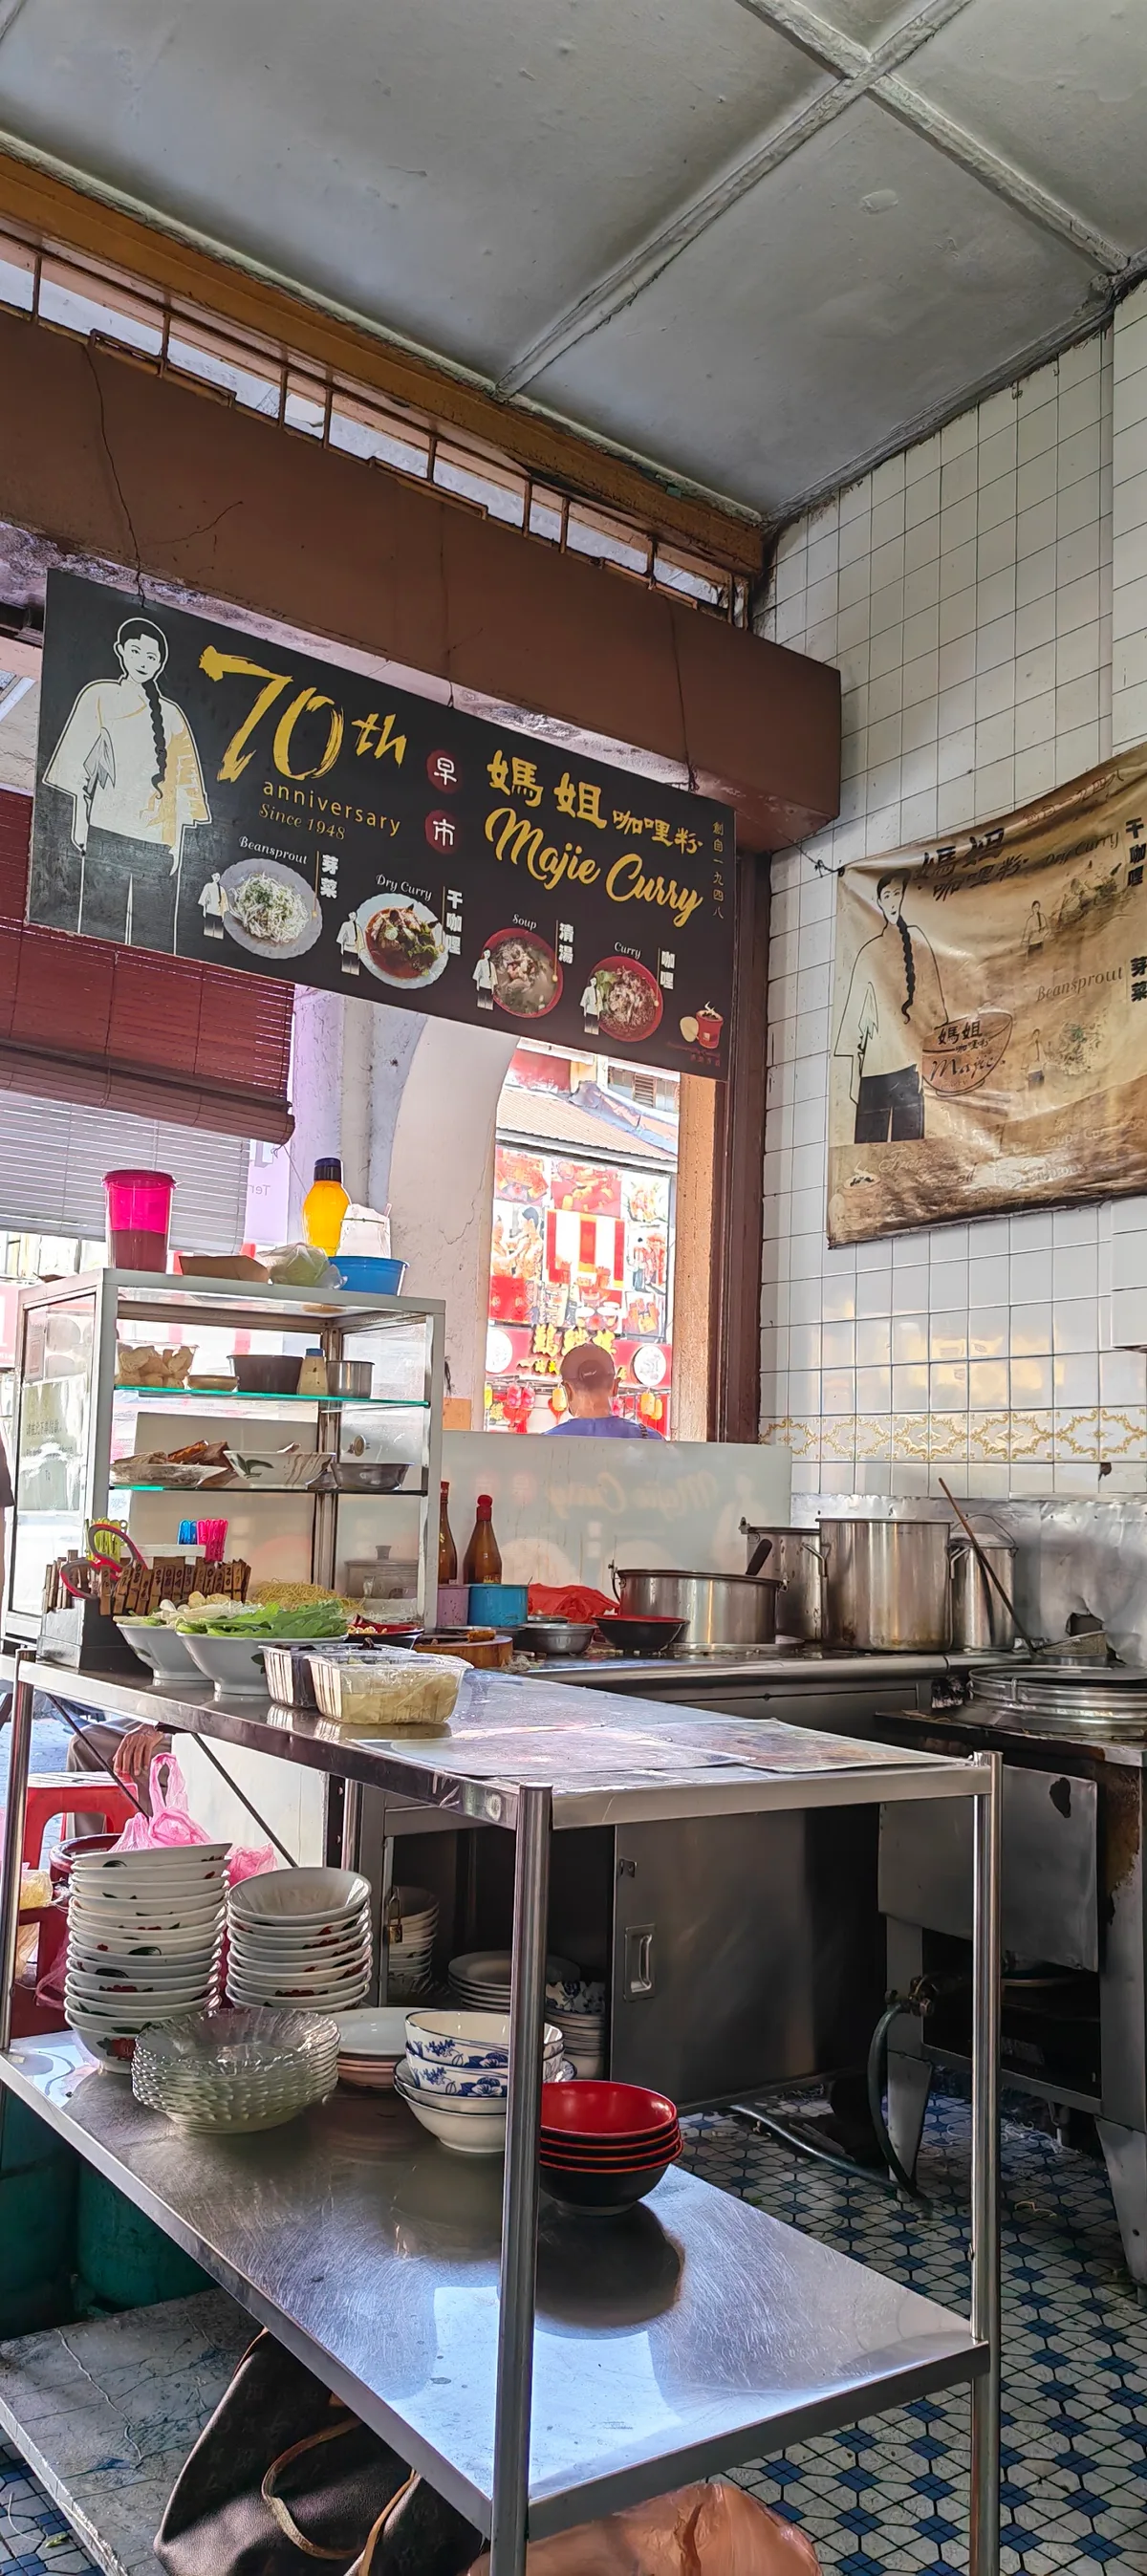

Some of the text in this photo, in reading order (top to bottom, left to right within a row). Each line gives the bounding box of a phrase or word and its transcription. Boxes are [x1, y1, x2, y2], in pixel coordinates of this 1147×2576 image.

[198, 644, 408, 784] 70th
[258, 802, 346, 842] Since 1948
[262, 781, 402, 837] anniversary
[486, 748, 704, 856] 媽姐 咖哩粉
[238, 834, 309, 866] Beansprout
[1074, 830, 1121, 856] Curry
[1125, 816, 1147, 888] 干咖哩
[320, 854, 340, 899] 芽菜
[376, 874, 434, 902] Dry Curry
[484, 806, 704, 928] Majie Curry
[711, 820, 725, 920] 創自一九四八
[446, 889, 465, 956] 干咖哩
[511, 913, 538, 931] Soup
[558, 921, 575, 965] 清湯
[614, 941, 642, 961] Curry
[660, 949, 677, 991] 咖哩
[1036, 965, 1123, 1003] Beansprout
[1130, 955, 1147, 1003] 芽菜
[937, 1020, 984, 1046] 媽姐
